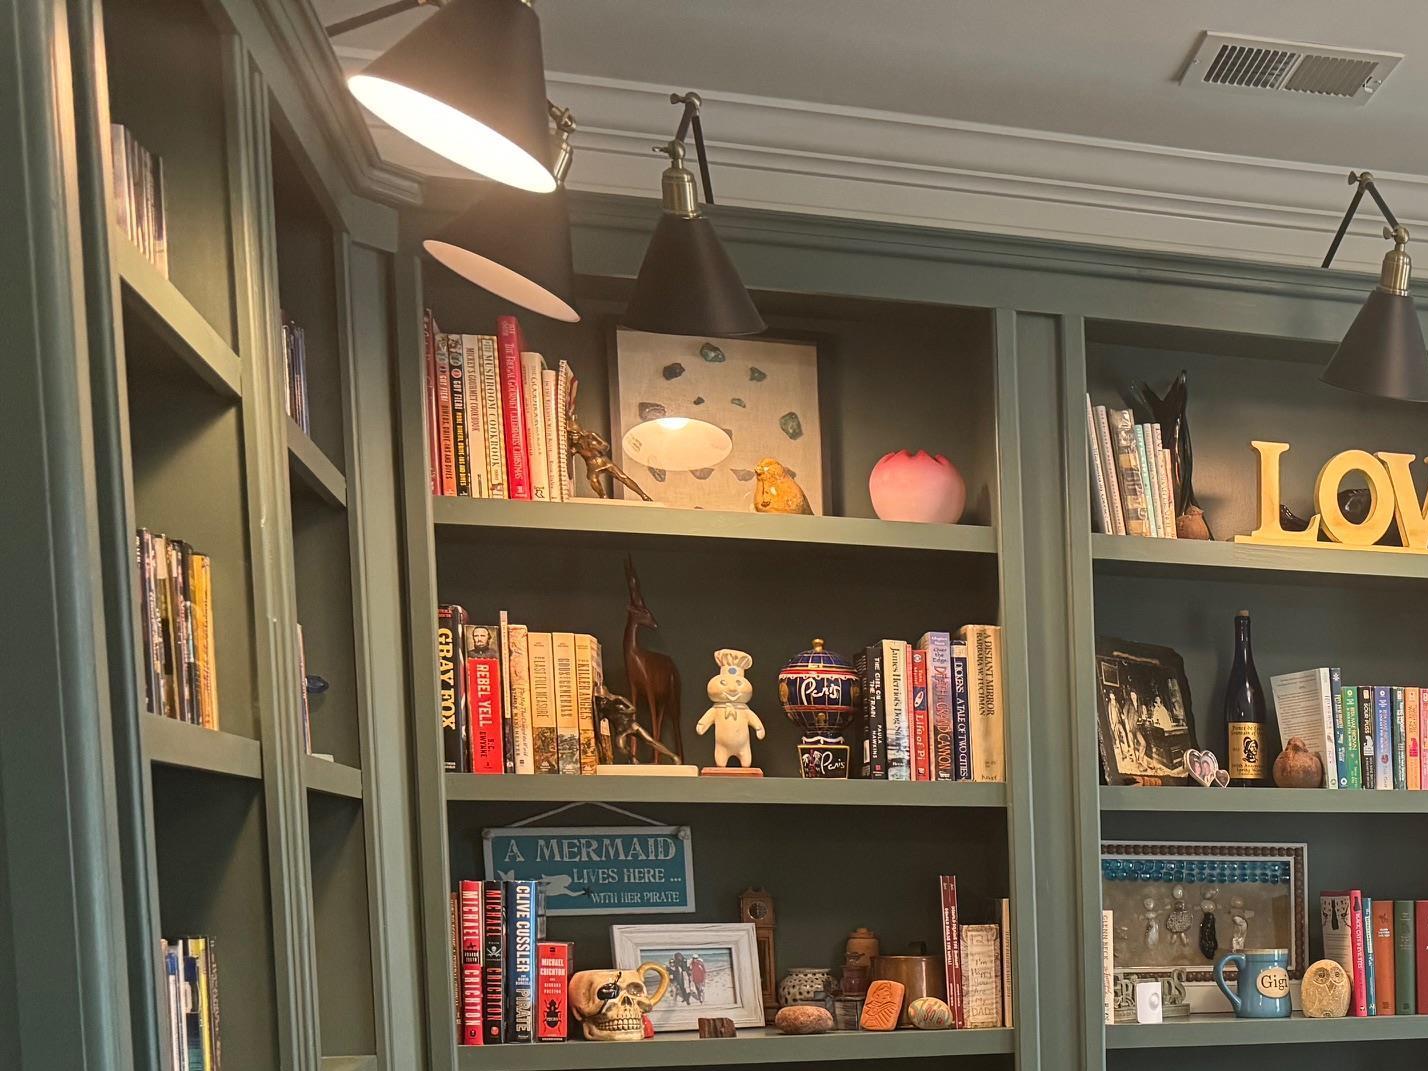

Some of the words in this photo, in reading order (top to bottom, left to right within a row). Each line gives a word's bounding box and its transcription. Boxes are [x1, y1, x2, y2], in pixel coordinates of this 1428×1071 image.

[484, 355, 495, 409] MUSHROOM
[439, 628, 454, 685] GRAY
[976, 632, 985, 666] BARBARA
[984, 641, 993, 678] DISTANT
[476, 664, 491, 697] REBEL
[578, 663, 590, 690] KILLER
[955, 662, 964, 693] DICKENS
[441, 688, 456, 729] FOX
[957, 704, 965, 722] TALE
[978, 677, 986, 716] TUCHMAN
[986, 679, 994, 716] MIRROR
[479, 701, 492, 726] YELL
[958, 724, 966, 734] OF
[959, 736, 967, 753] TWO
[820, 751, 845, 774] Paris
[960, 754, 968, 777] CITIES
[504, 839, 525, 862] A
[536, 837, 676, 862] MERMAID
[573, 868, 619, 884] LIVES
[623, 868, 665, 883] HERE
[486, 890, 502, 937] MICHAEL
[516, 885, 530, 918] CLIVE
[591, 892, 618, 903] WITH
[621, 892, 642, 903] HER
[644, 891, 680, 903] PIRATE
[462, 890, 479, 941] MICHAEL
[516, 921, 531, 972] CUSSLER
[464, 970, 480, 1026] CRICHTON
[487, 967, 503, 1021] CRICHTON
[1261, 975, 1288, 991] Gigi
[516, 988, 531, 1032] PIRATE
